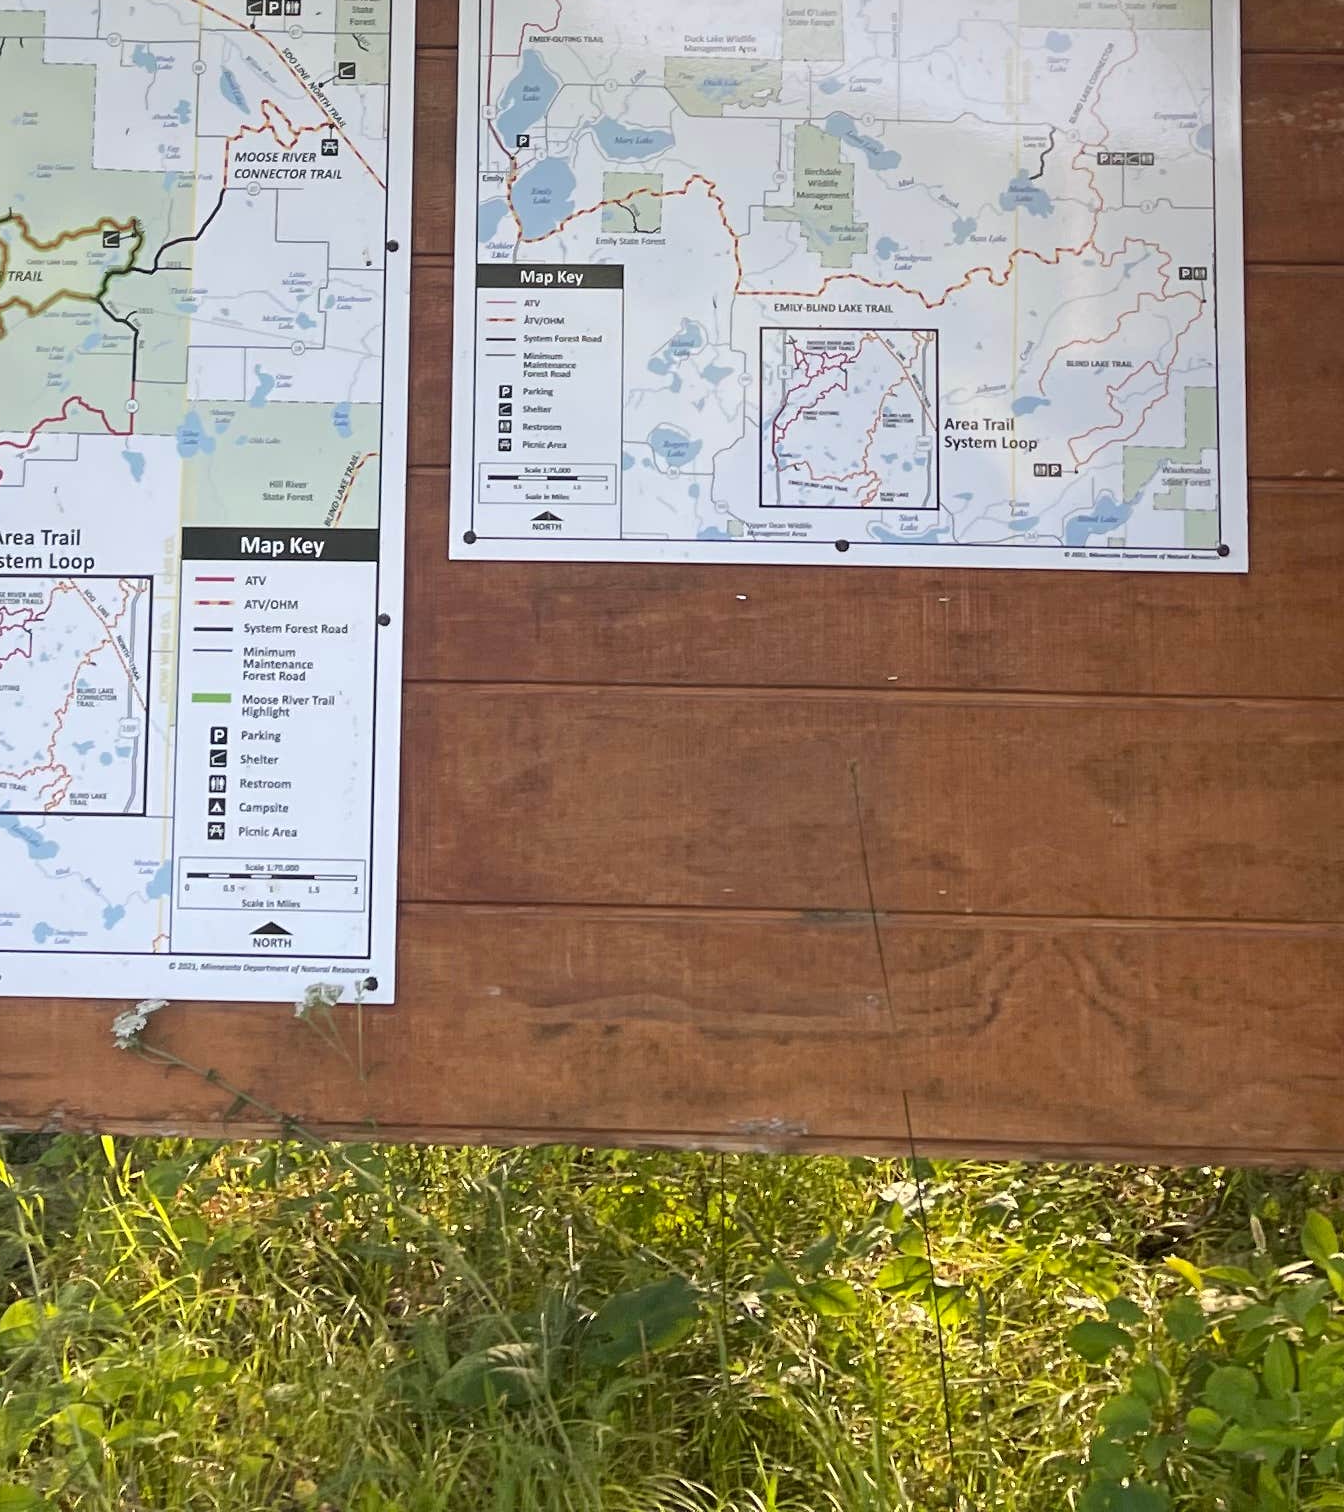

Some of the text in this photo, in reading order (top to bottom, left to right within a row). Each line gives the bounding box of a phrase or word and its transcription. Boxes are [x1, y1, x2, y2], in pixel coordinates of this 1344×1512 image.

[308, 82, 331, 109] NORTH
[326, 105, 347, 128] TRAIL
[235, 152, 316, 162] MOOSE RIVER
[234, 169, 342, 179] CONNECTOR TRAIL
[482, 174, 504, 184] Emily
[596, 237, 617, 247] Emily
[620, 237, 639, 245] State
[8, 271, 44, 282] TRAIL
[520, 271, 584, 284] Map Key
[774, 304, 893, 313] EMILY-BLIND LAKE TRAIL
[524, 336, 552, 344] System
[523, 388, 553, 396] Parking
[944, 418, 1014, 430] Area Trail
[944, 436, 1037, 451] System Loop
[324, 454, 359, 527] BLIND LAKE TRAIL
[42, 530, 80, 546] Trail
[240, 536, 324, 557] Map Key
[50, 554, 94, 572] Loop
[245, 576, 266, 586] ATV
[244, 600, 298, 610] ATV/OHM
[244, 624, 348, 634] System Forest Road
[244, 647, 296, 657] Minimum
[244, 660, 314, 670] Maintenance
[243, 672, 306, 681] Forest Road
[242, 696, 335, 706] Moose River Trail
[242, 707, 290, 718] Highlight
[242, 731, 281, 742] Parking
[240, 755, 278, 764] Shelter
[240, 779, 292, 789] Restroom
[240, 803, 289, 814] Campsite
[239, 828, 298, 837] Picnic Area
[242, 900, 300, 908] Scale in Miles
[253, 938, 292, 948] NORTH
